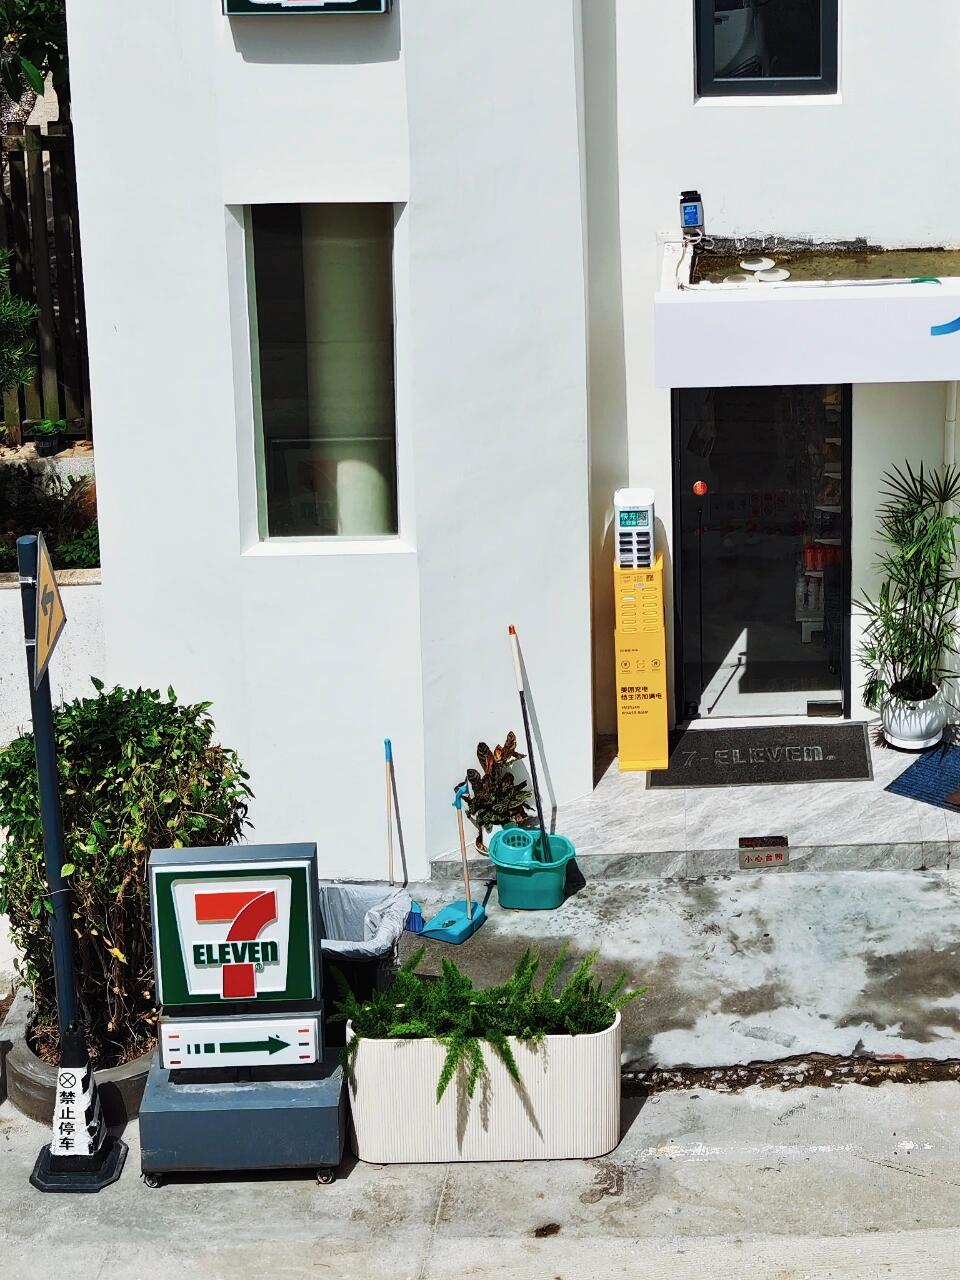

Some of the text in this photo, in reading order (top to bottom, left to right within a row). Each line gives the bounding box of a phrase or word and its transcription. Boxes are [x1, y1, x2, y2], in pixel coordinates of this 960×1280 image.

[620, 512, 637, 521] 快充
[194, 890, 278, 999] 7
[59, 1091, 76, 1150] 禁止停车
